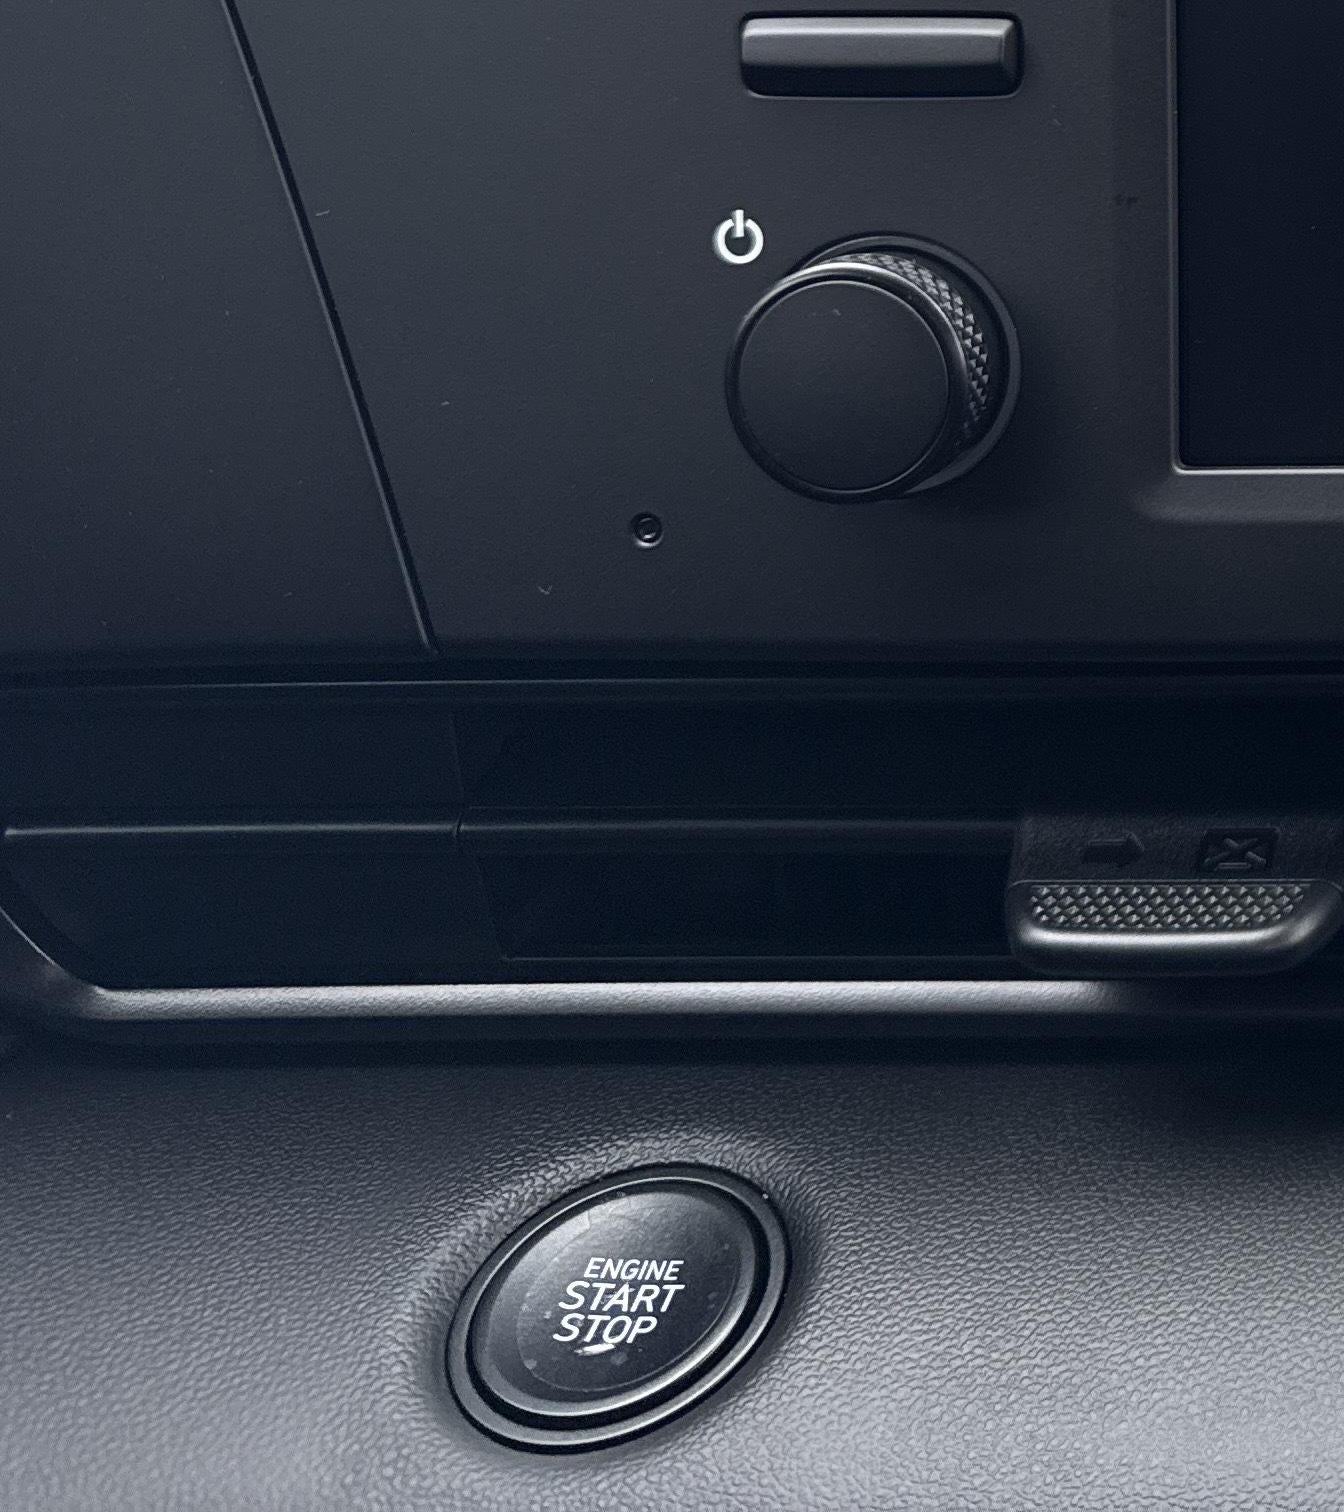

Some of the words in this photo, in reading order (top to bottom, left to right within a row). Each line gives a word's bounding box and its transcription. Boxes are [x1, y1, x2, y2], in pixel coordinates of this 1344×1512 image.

[583, 1257, 684, 1281] ENGINE
[558, 1281, 685, 1313] START
[552, 1313, 658, 1345] STOP
